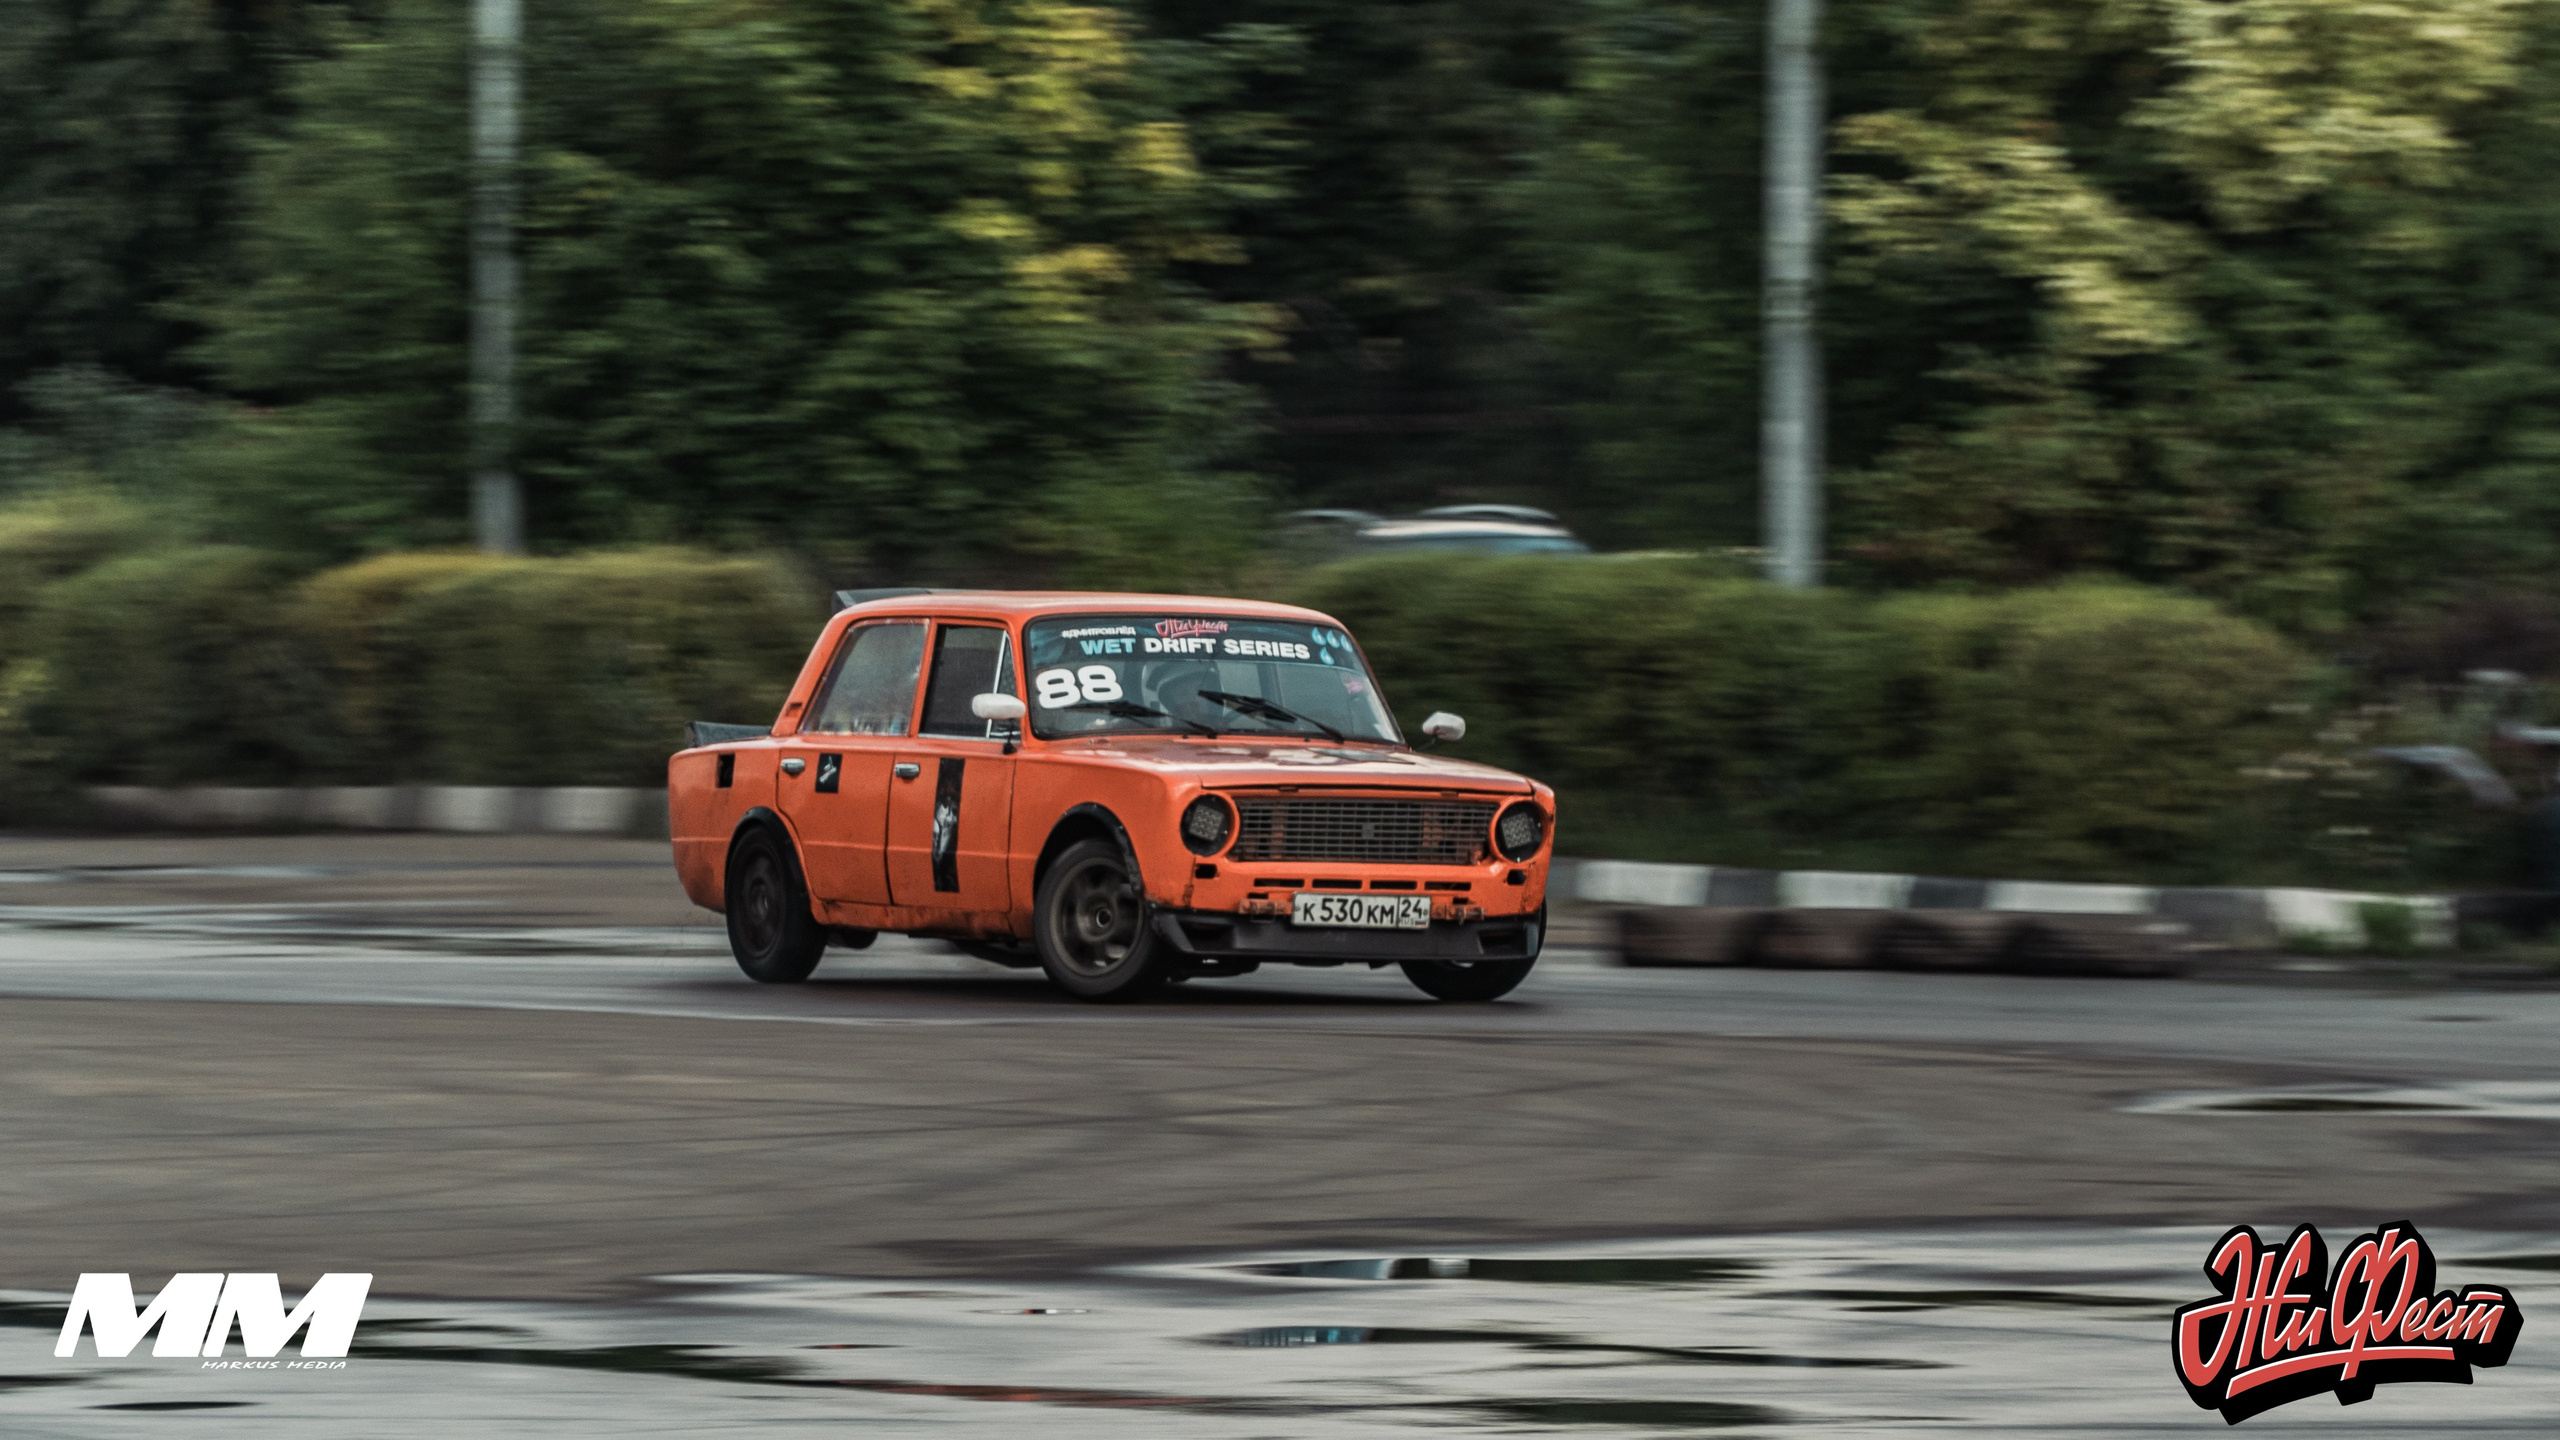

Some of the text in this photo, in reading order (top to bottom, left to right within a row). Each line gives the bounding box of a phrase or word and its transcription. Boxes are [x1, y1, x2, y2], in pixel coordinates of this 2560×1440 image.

[1080, 637, 1310, 660] WET DRIFT SERIES
[1035, 665, 1123, 710] 88
[1401, 899, 1422, 918] 24
